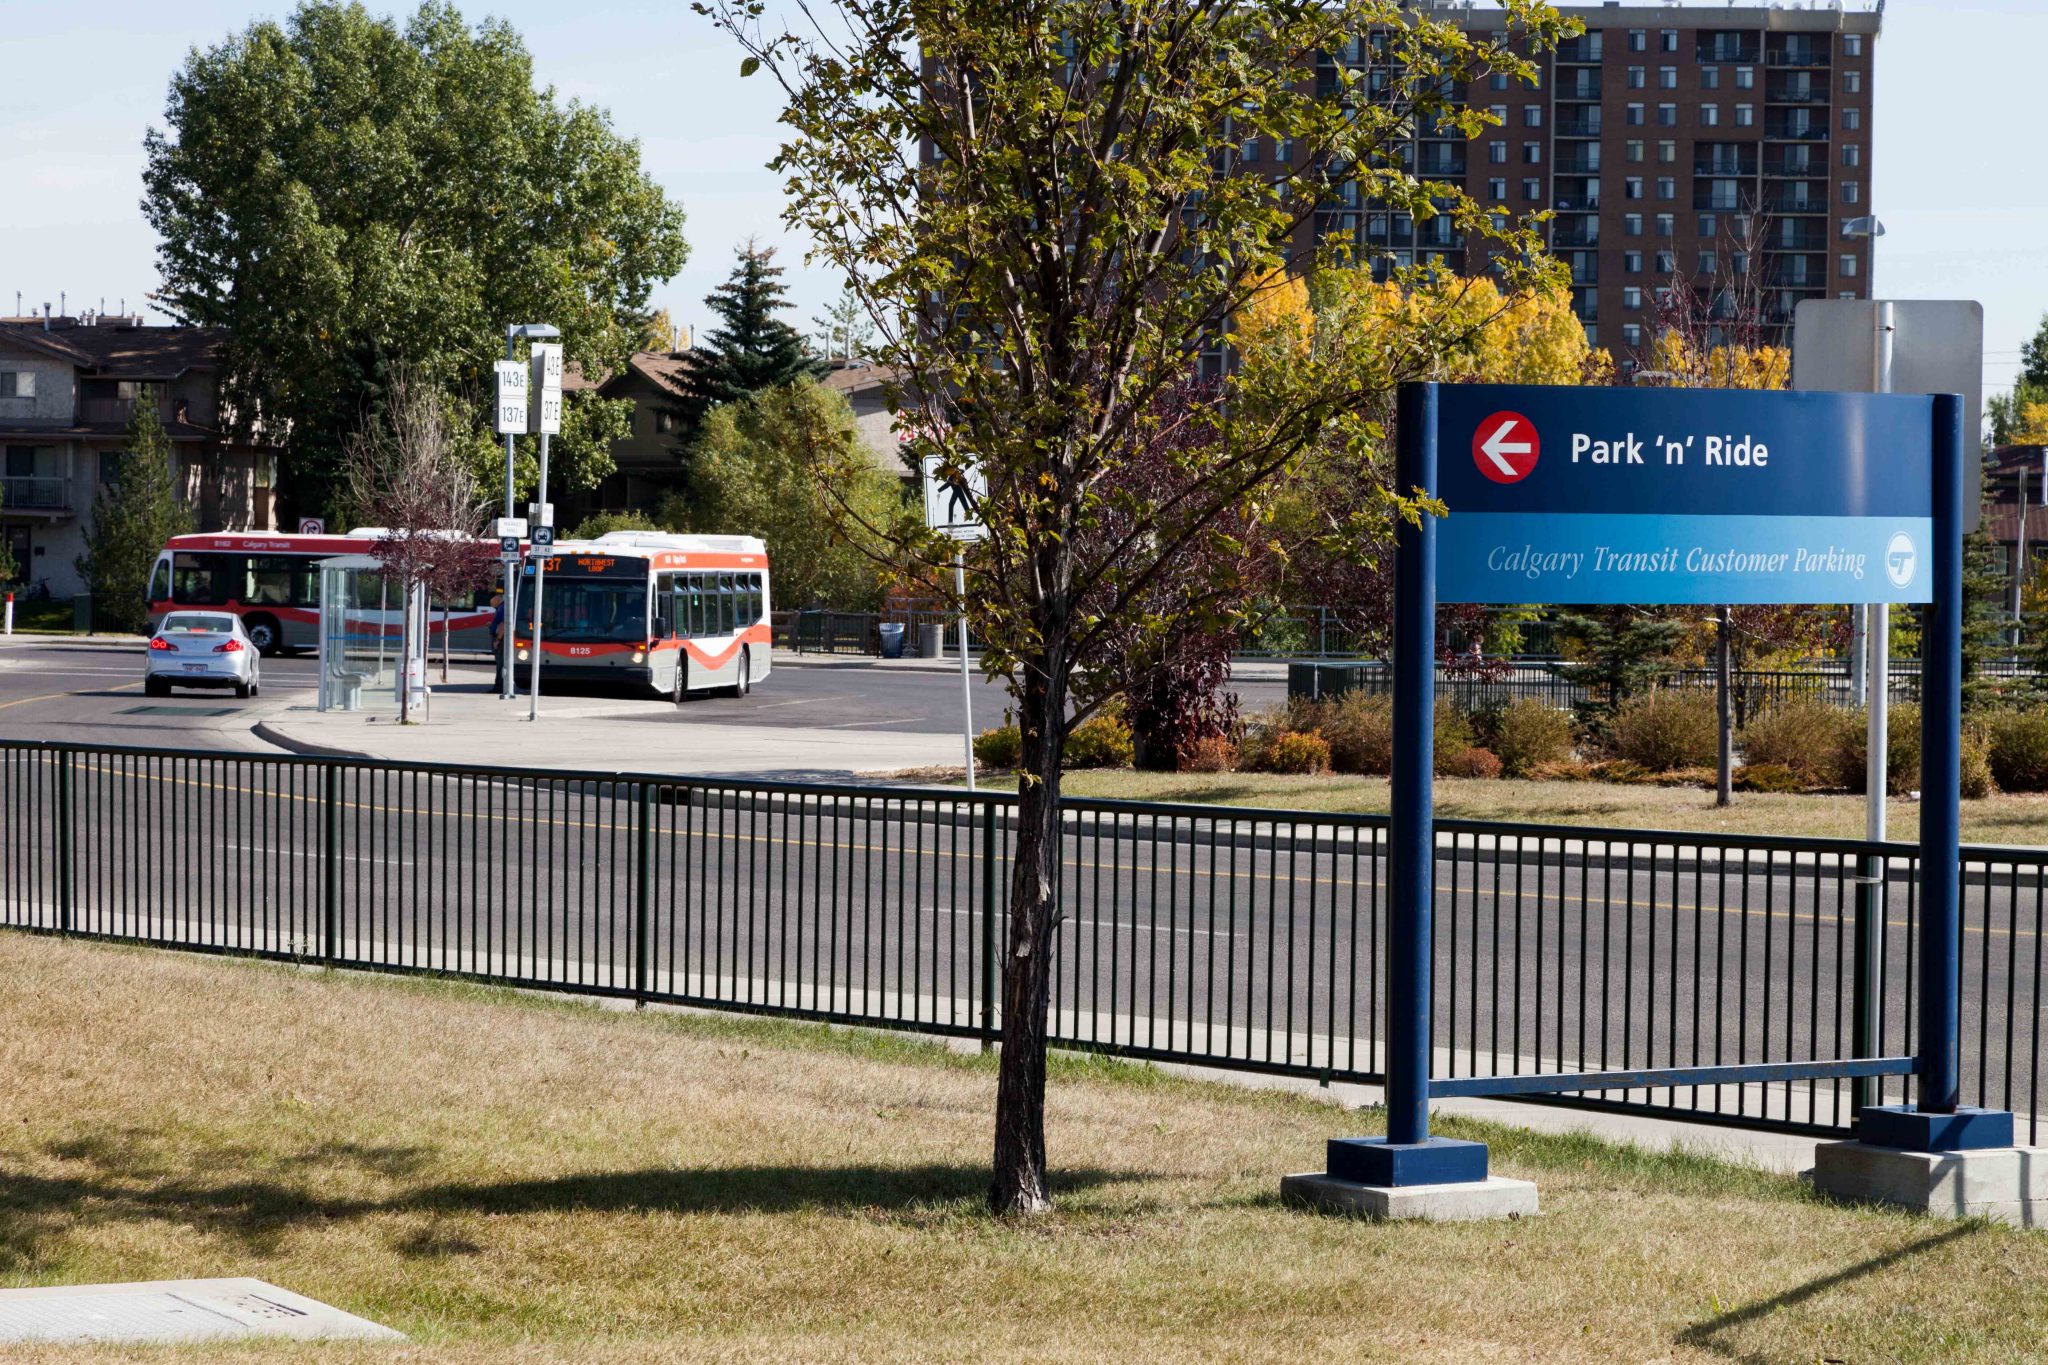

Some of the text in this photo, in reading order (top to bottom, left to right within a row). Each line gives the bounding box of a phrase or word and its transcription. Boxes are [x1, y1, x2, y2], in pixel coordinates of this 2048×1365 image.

[502, 371, 525, 388] 143E
[502, 406, 524, 423] 137E
[1572, 432, 1645, 465] Park
[1705, 435, 1769, 467] Ride
[242, 540, 267, 549] Calgary
[543, 557, 561, 571] 37
[1487, 544, 1866, 580] Calgary Transit Customer Parking
[570, 647, 591, 655] 8125
